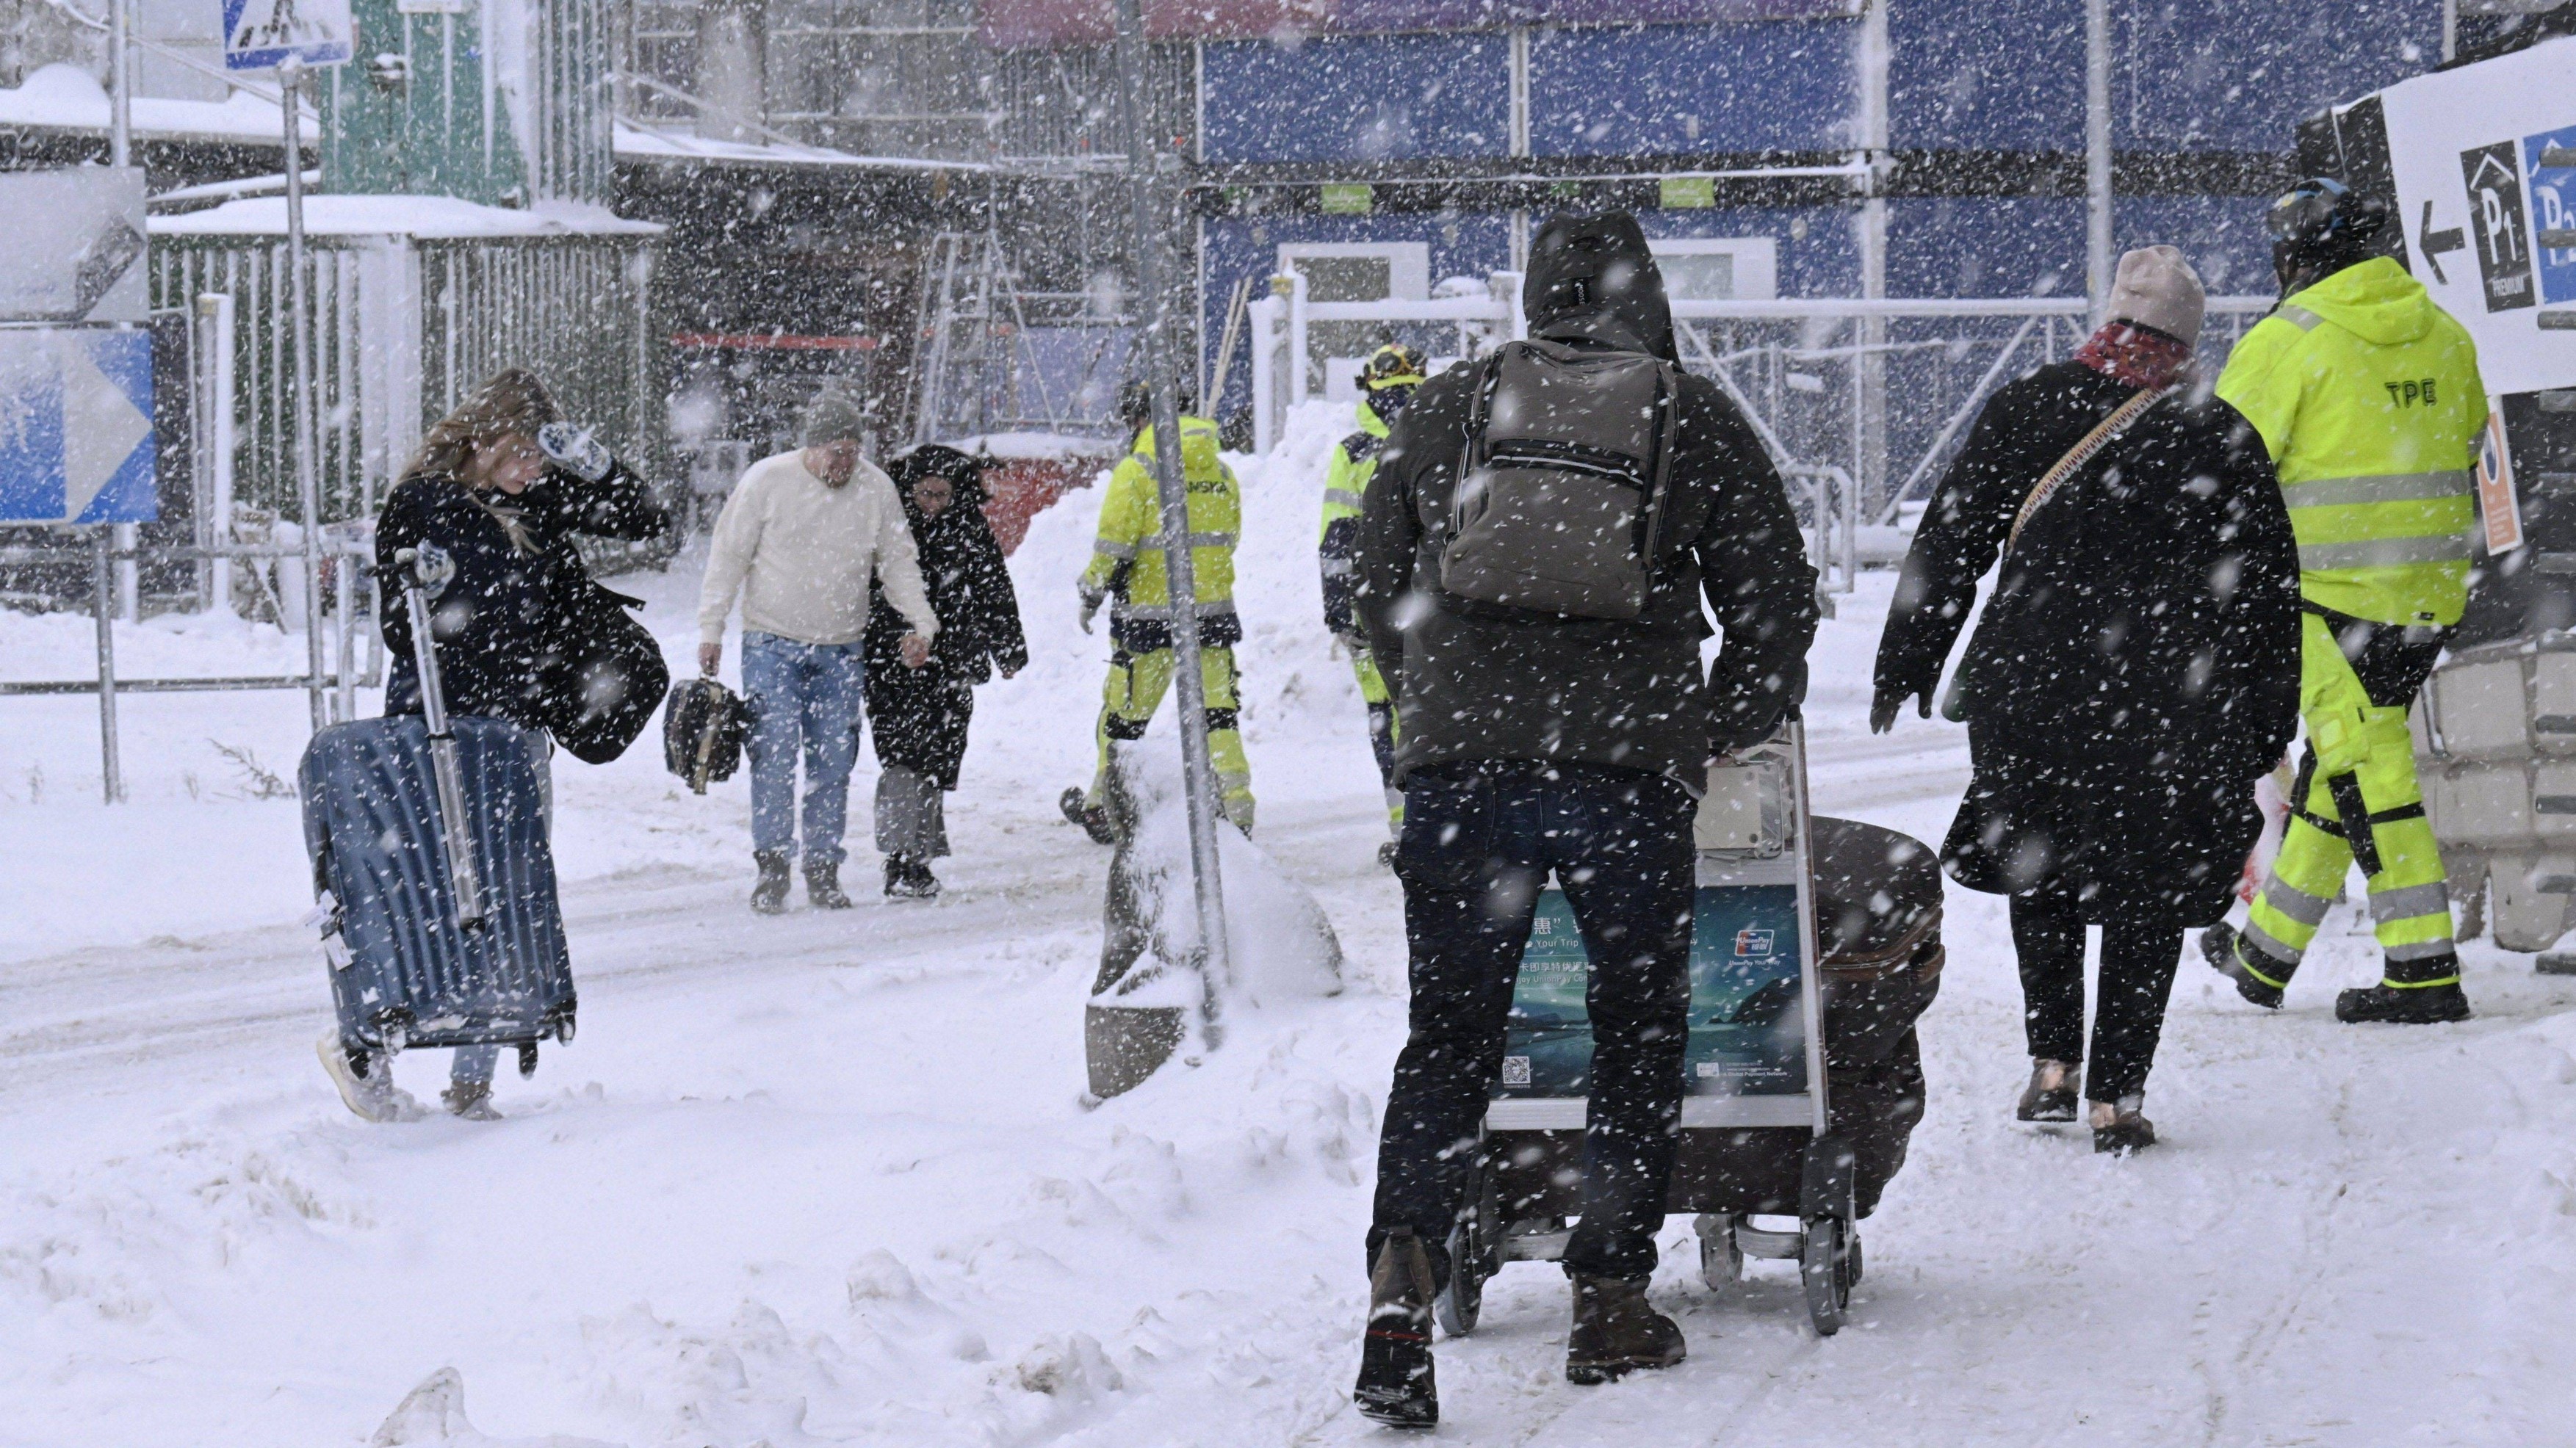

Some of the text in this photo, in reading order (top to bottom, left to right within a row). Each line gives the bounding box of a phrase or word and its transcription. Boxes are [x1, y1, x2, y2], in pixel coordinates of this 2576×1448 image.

[2481, 187, 2517, 265] P1
[2492, 275, 2525, 297] PREMIUM
[2384, 377, 2437, 408] TPE
[1536, 939, 1557, 948] Your
[1561, 938, 1579, 948] Trip
[1533, 974, 1572, 984] UnionPay
